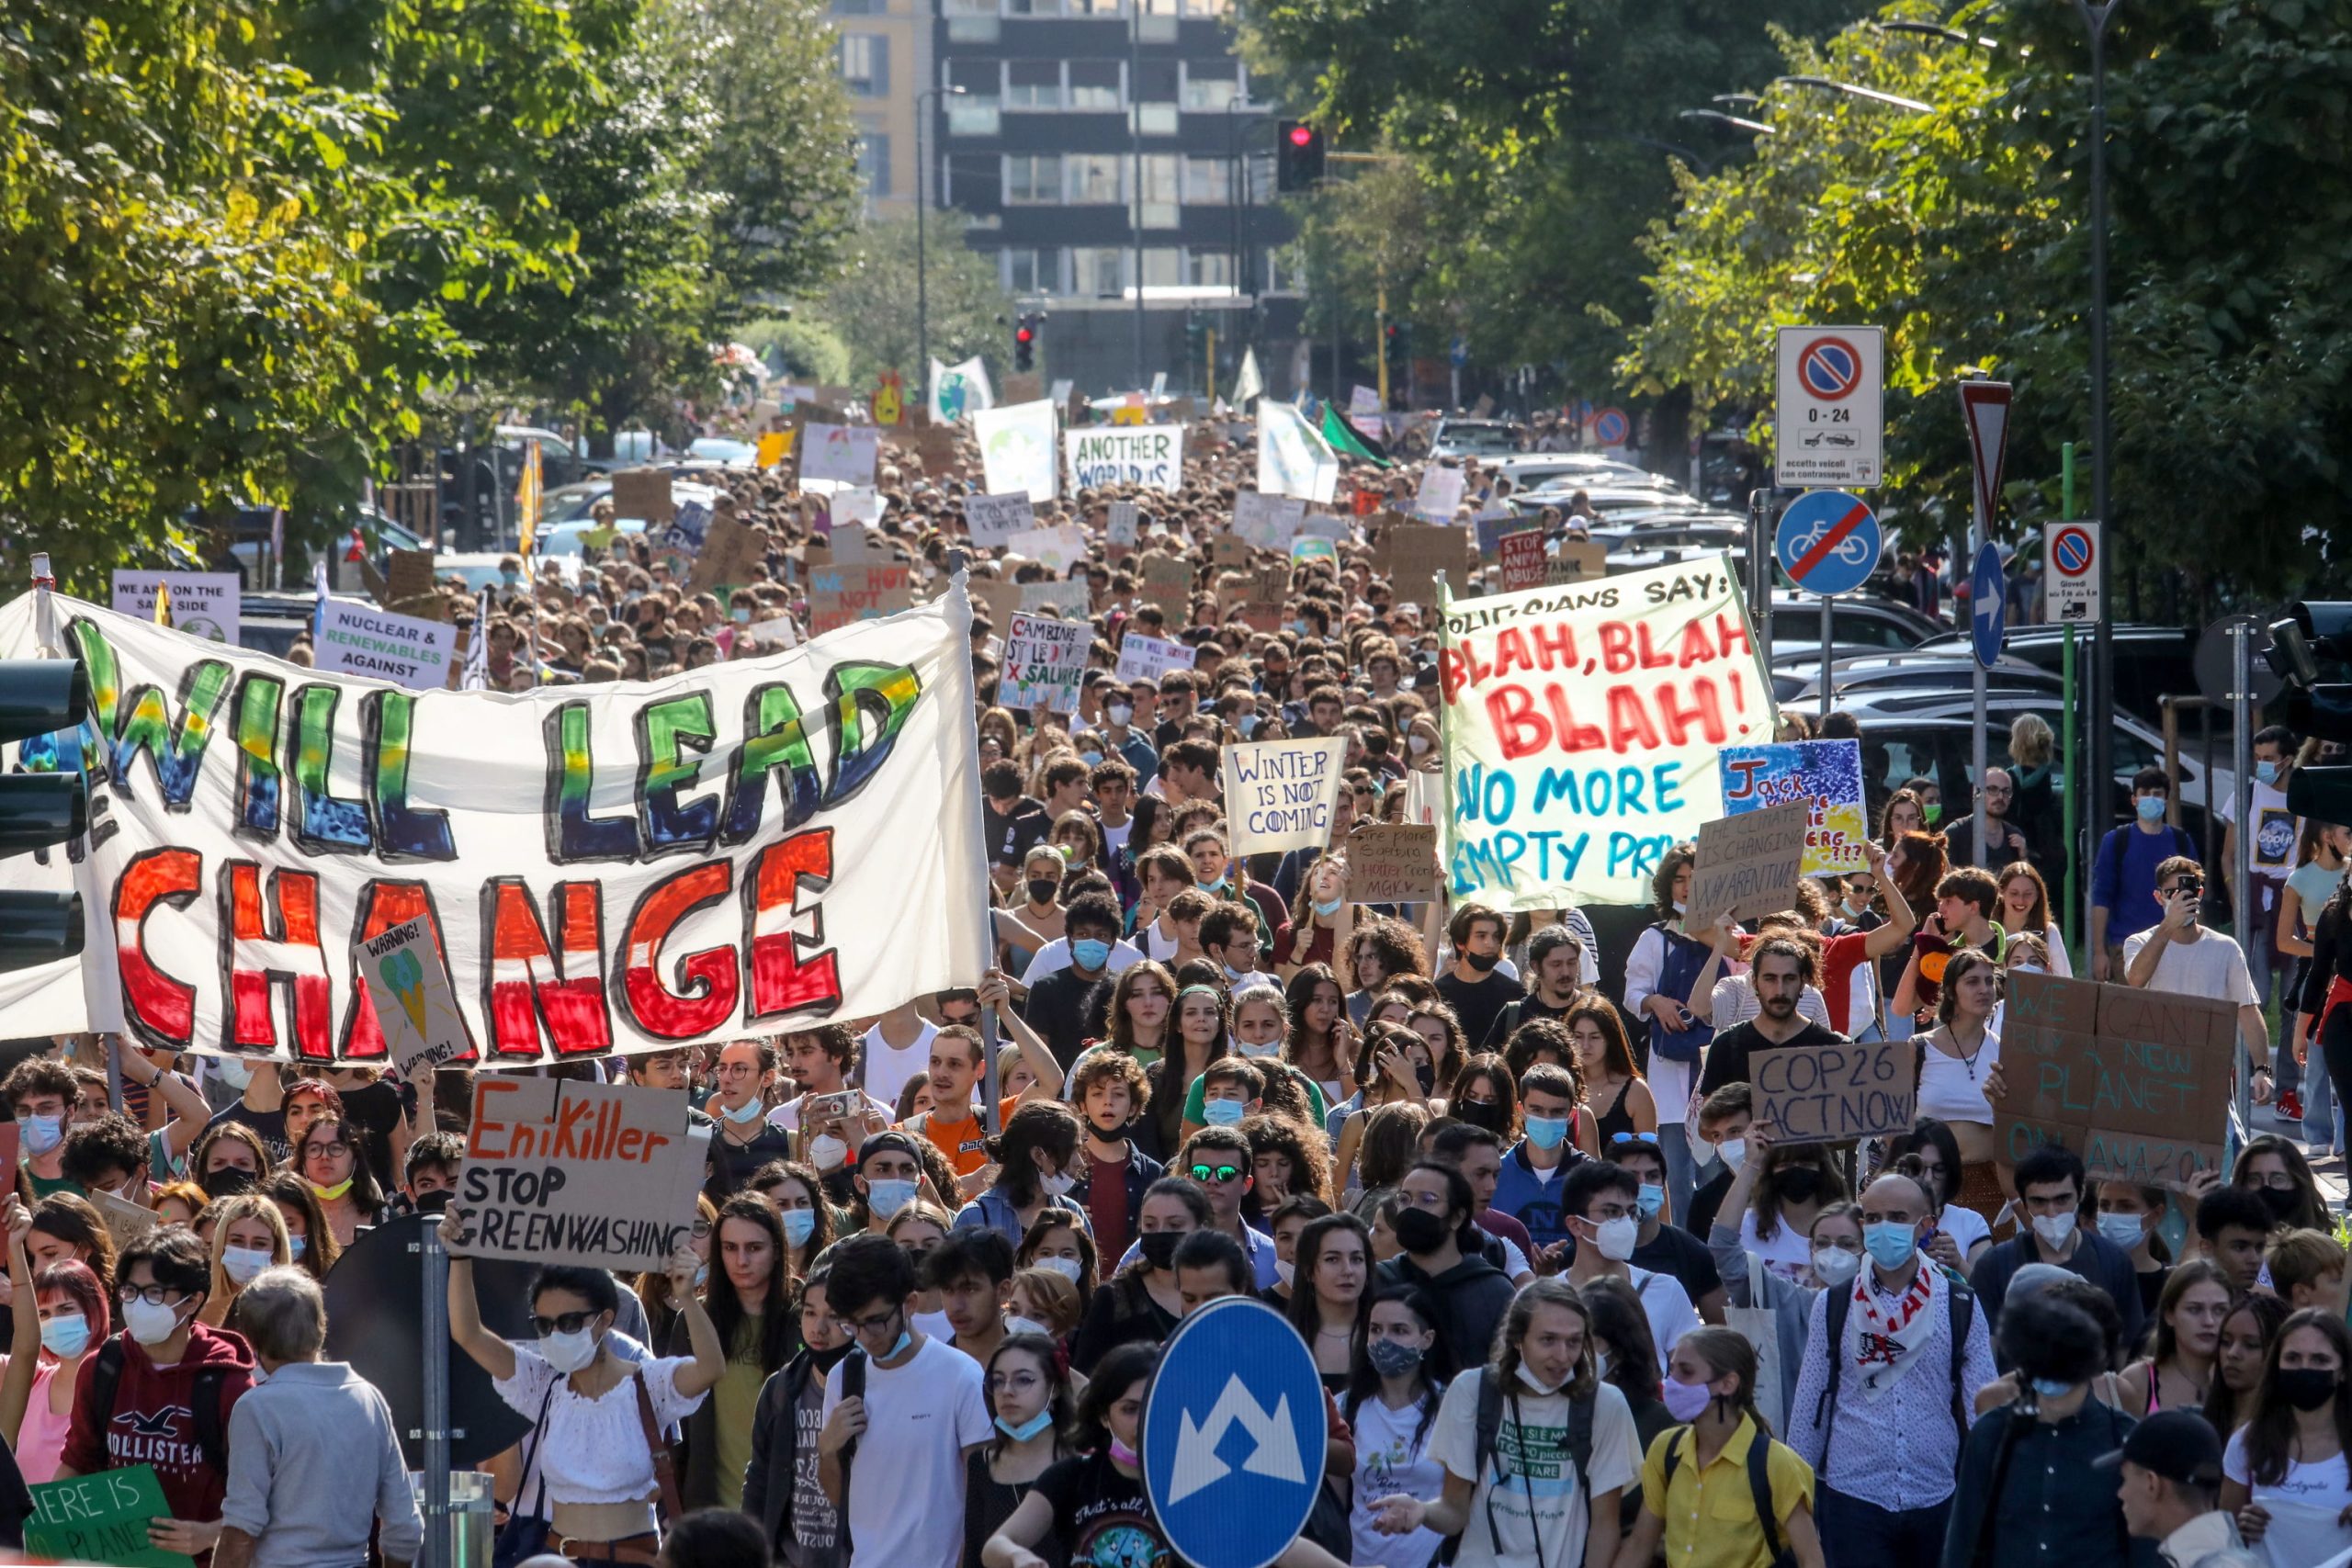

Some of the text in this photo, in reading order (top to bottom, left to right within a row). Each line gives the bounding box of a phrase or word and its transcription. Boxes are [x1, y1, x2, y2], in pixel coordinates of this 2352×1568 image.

[1809, 409, 1817, 423] 0
[1832, 409, 1849, 423] 24
[1077, 434, 1170, 460] ANOTHER
[1786, 459, 1846, 468] eccetto veicoli
[1781, 469, 1850, 479] con contrassegno
[1504, 534, 1541, 554] STOP
[867, 565, 910, 590] HOT
[1506, 565, 1544, 583] ABUSE
[1645, 572, 1727, 604] SAY:
[119, 584, 223, 598] WE AR ON THE
[137, 599, 209, 612] SA SIDE
[839, 591, 881, 610] NOT
[339, 613, 435, 644] NUCLEAR &
[1012, 619, 1077, 641] CAMBIARE
[325, 628, 442, 666] RENEWABLES
[342, 652, 419, 679] AGAINST
[1007, 662, 1082, 686] X SALVARE
[1485, 669, 1749, 761] BLAH!
[62, 613, 459, 863] WILL
[542, 659, 922, 865] LEAD
[1233, 749, 1328, 784] WINTER
[1257, 778, 1324, 807] IS NOT
[1454, 761, 1686, 827] NO MORE
[1249, 803, 1328, 834] COMING
[1704, 823, 1730, 842] THE
[1737, 807, 1801, 837] CLIMATE
[1453, 829, 1590, 897] EMPTY
[1700, 829, 1803, 869] IS CHANGING
[111, 826, 842, 1066] CHANGE
[366, 922, 420, 958] WARNING!
[2009, 979, 2066, 1022] WE
[2012, 1026, 2064, 1055] BUY
[2122, 1041, 2192, 1075] NEW
[2038, 1062, 2201, 1114] PLANET
[1762, 1090, 1911, 1139] ACT NOW
[464, 1166, 566, 1208] STOP
[449, 1207, 691, 1259] GREENWASHING
[107, 1431, 202, 1465] HOLLISTER
[107, 1475, 141, 1510] IS
[1075, 1496, 1148, 1525] That's all,
